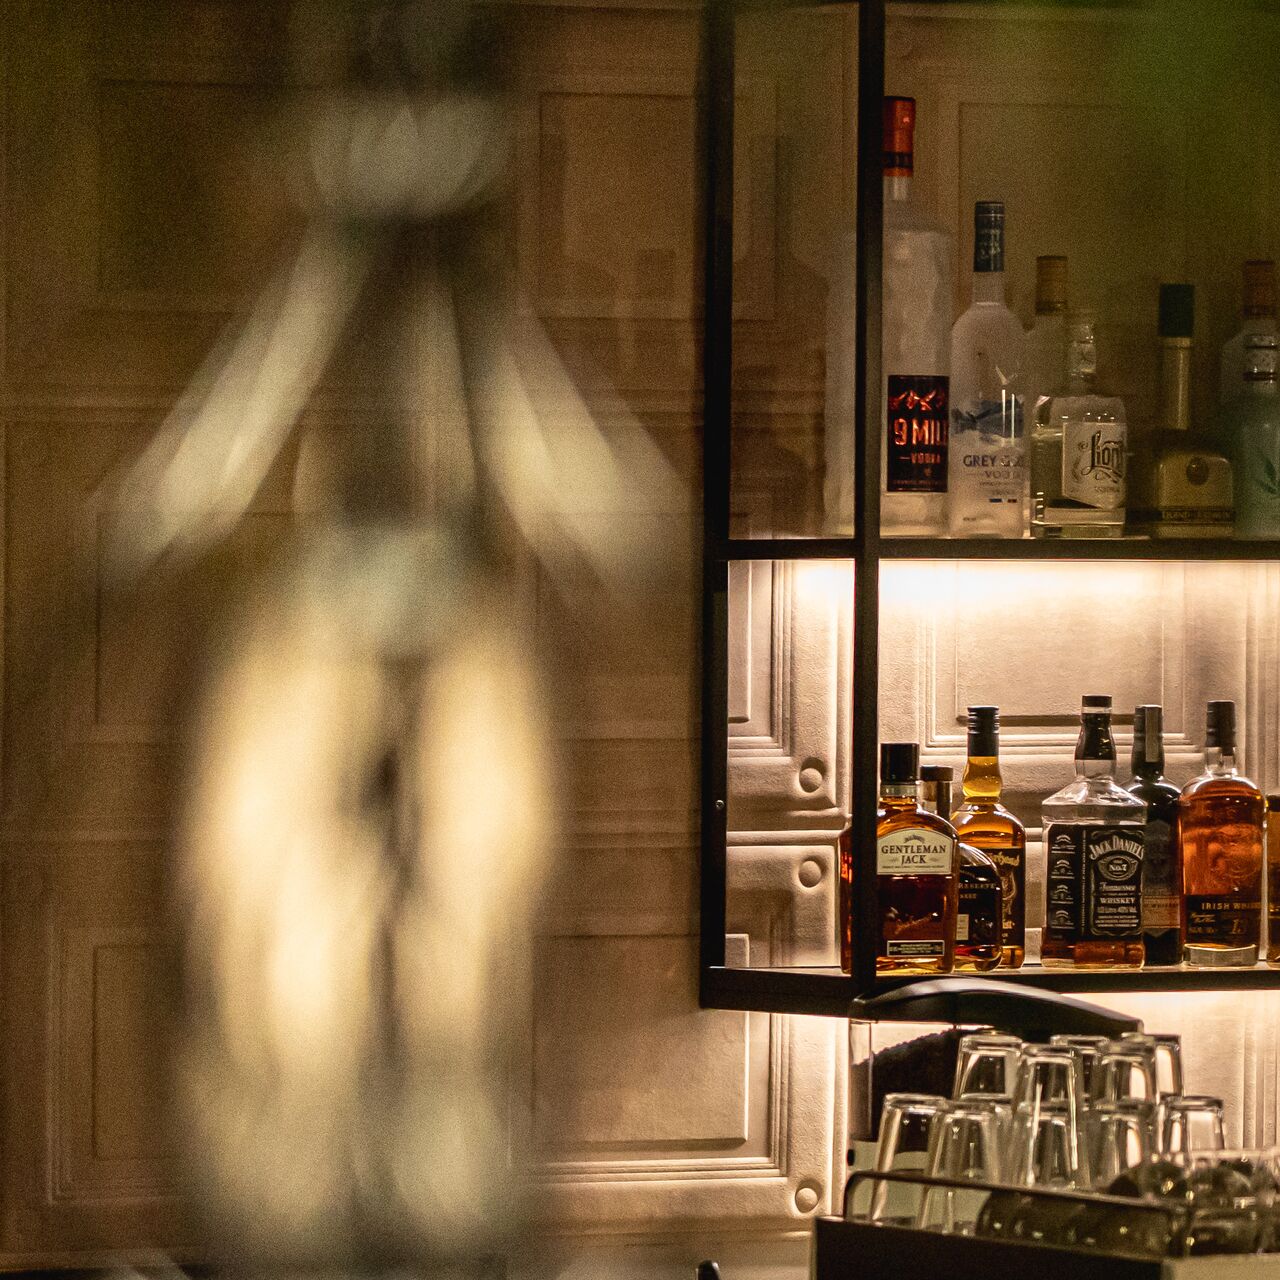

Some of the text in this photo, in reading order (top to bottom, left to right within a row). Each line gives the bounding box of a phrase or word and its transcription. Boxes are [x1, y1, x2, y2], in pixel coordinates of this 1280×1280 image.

[894, 417, 948, 446] 9 MIL
[962, 454, 998, 468] GREY
[880, 844, 947, 855] GENTLEMAN
[901, 855, 927, 865] JACK
[1099, 897, 1136, 905] WHISKEY
[1201, 902, 1231, 911] IRISH
